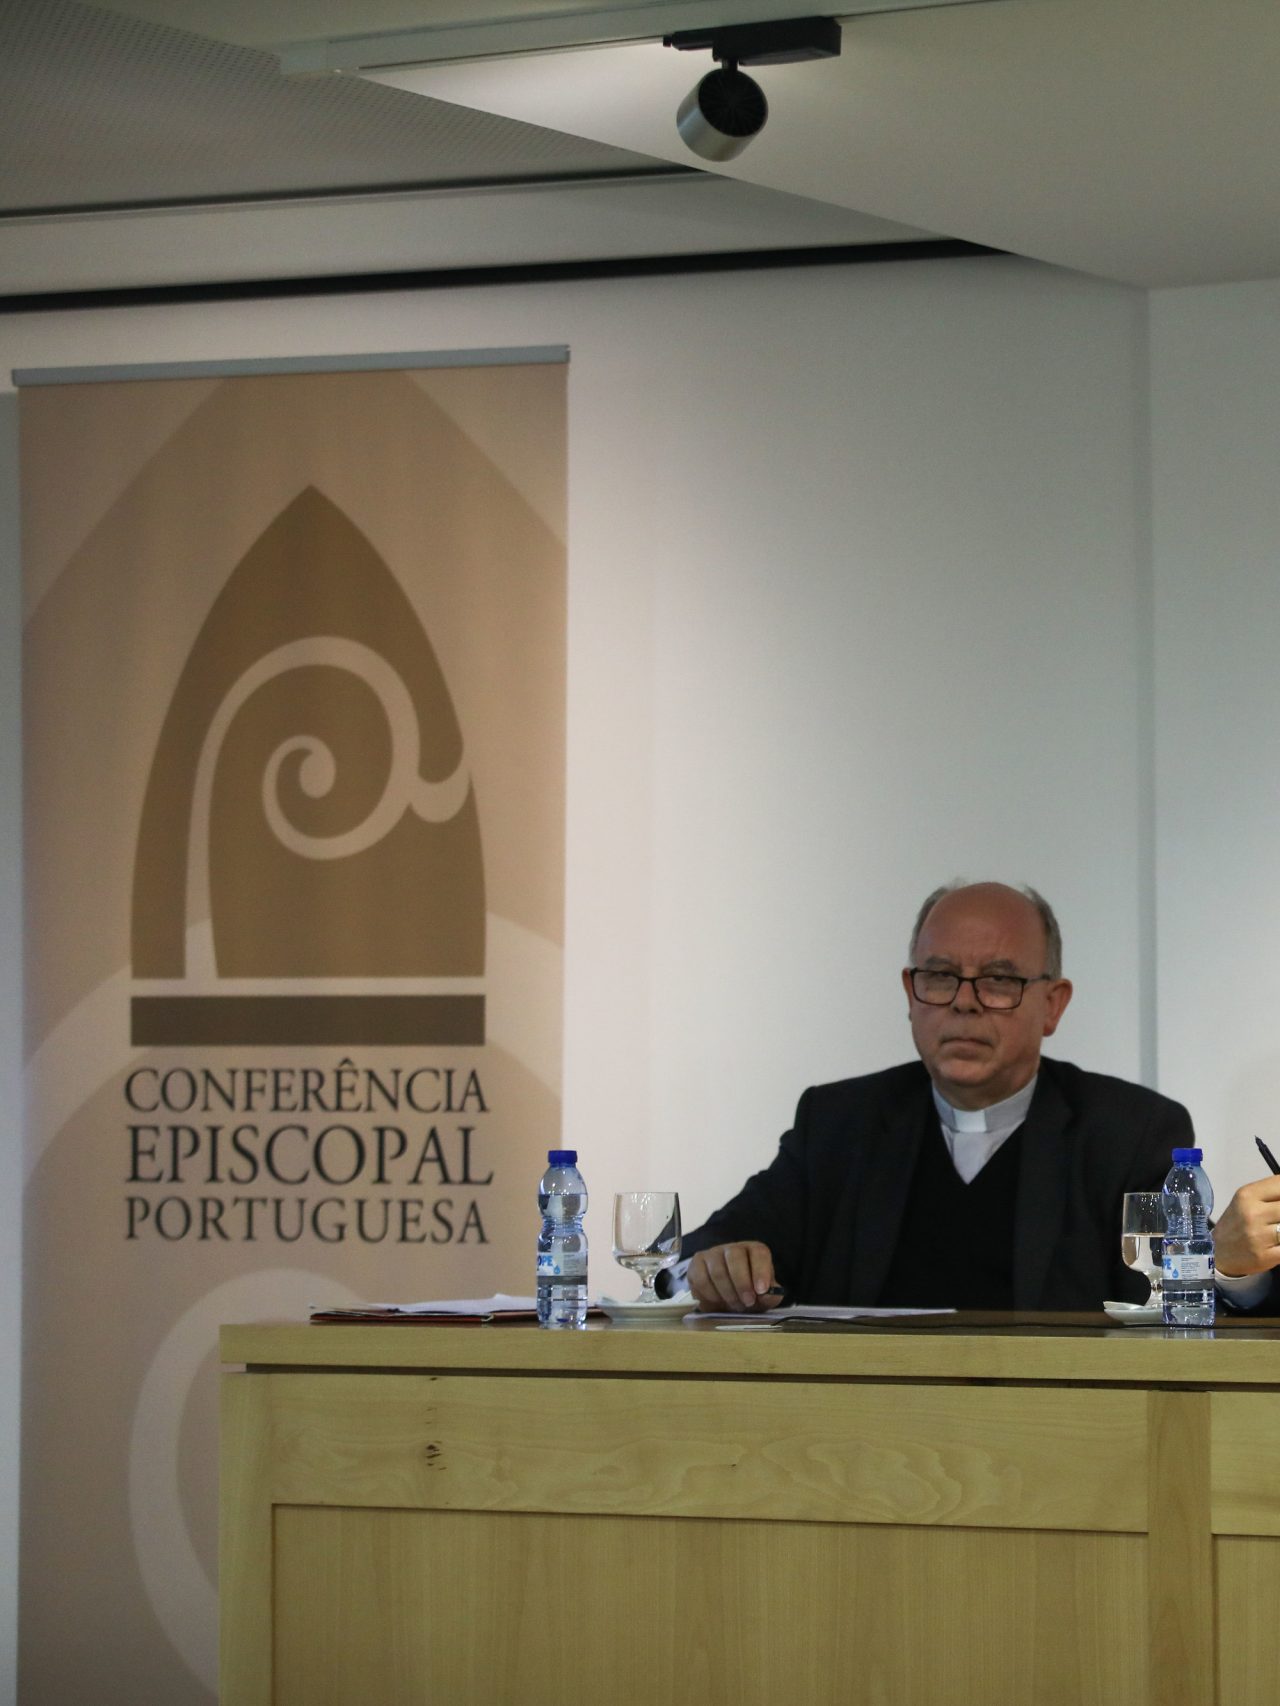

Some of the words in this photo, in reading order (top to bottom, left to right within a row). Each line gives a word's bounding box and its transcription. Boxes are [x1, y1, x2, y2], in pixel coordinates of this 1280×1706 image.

[125, 1058, 490, 1114] CONFERÊNCIA
[125, 1123, 494, 1186] EPISCOPAL
[125, 1195, 490, 1245] PORTUGUESA
